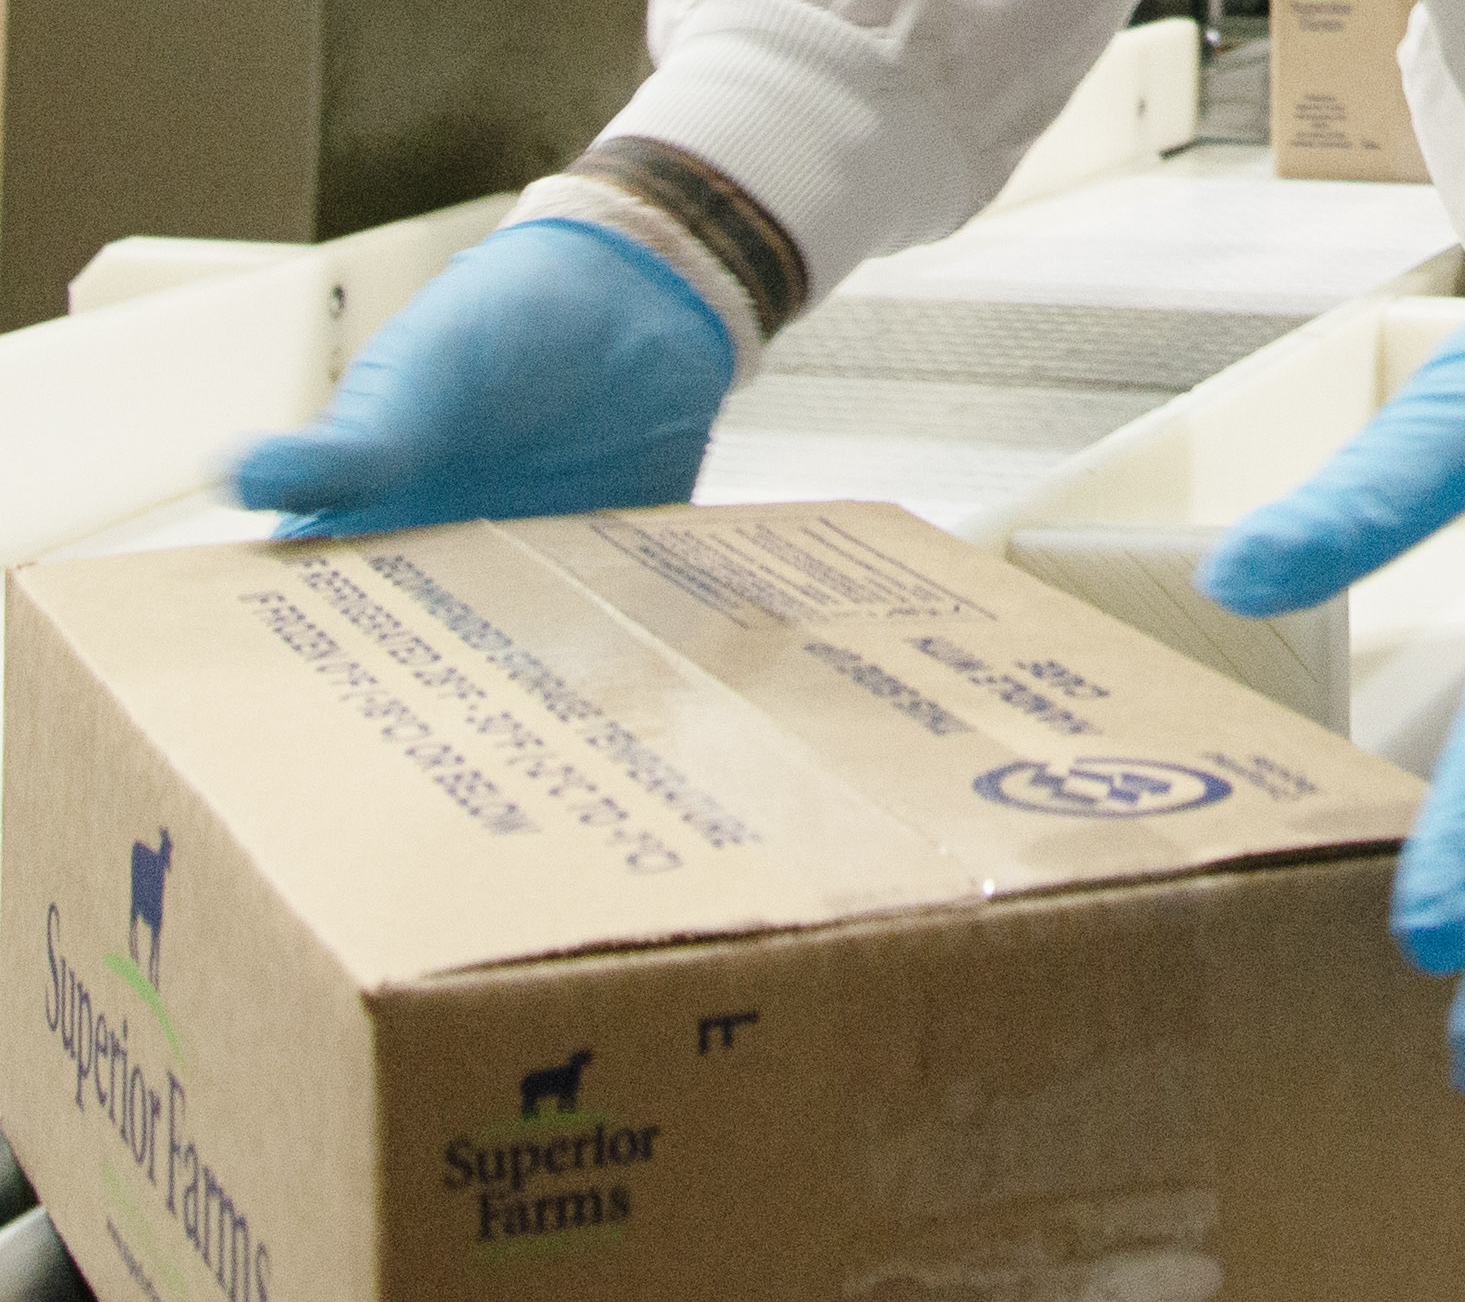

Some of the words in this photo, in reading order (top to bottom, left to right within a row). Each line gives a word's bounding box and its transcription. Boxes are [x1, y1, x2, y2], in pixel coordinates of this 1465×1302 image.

[247, 604, 353, 662] FROZEN
[395, 741, 475, 772] OR
[425, 769, 546, 838] BELOW
[45, 902, 162, 1188] Superior
[167, 1069, 273, 1302] Farms
[442, 1121, 661, 1193] Superior
[477, 1185, 632, 1243] Farms
